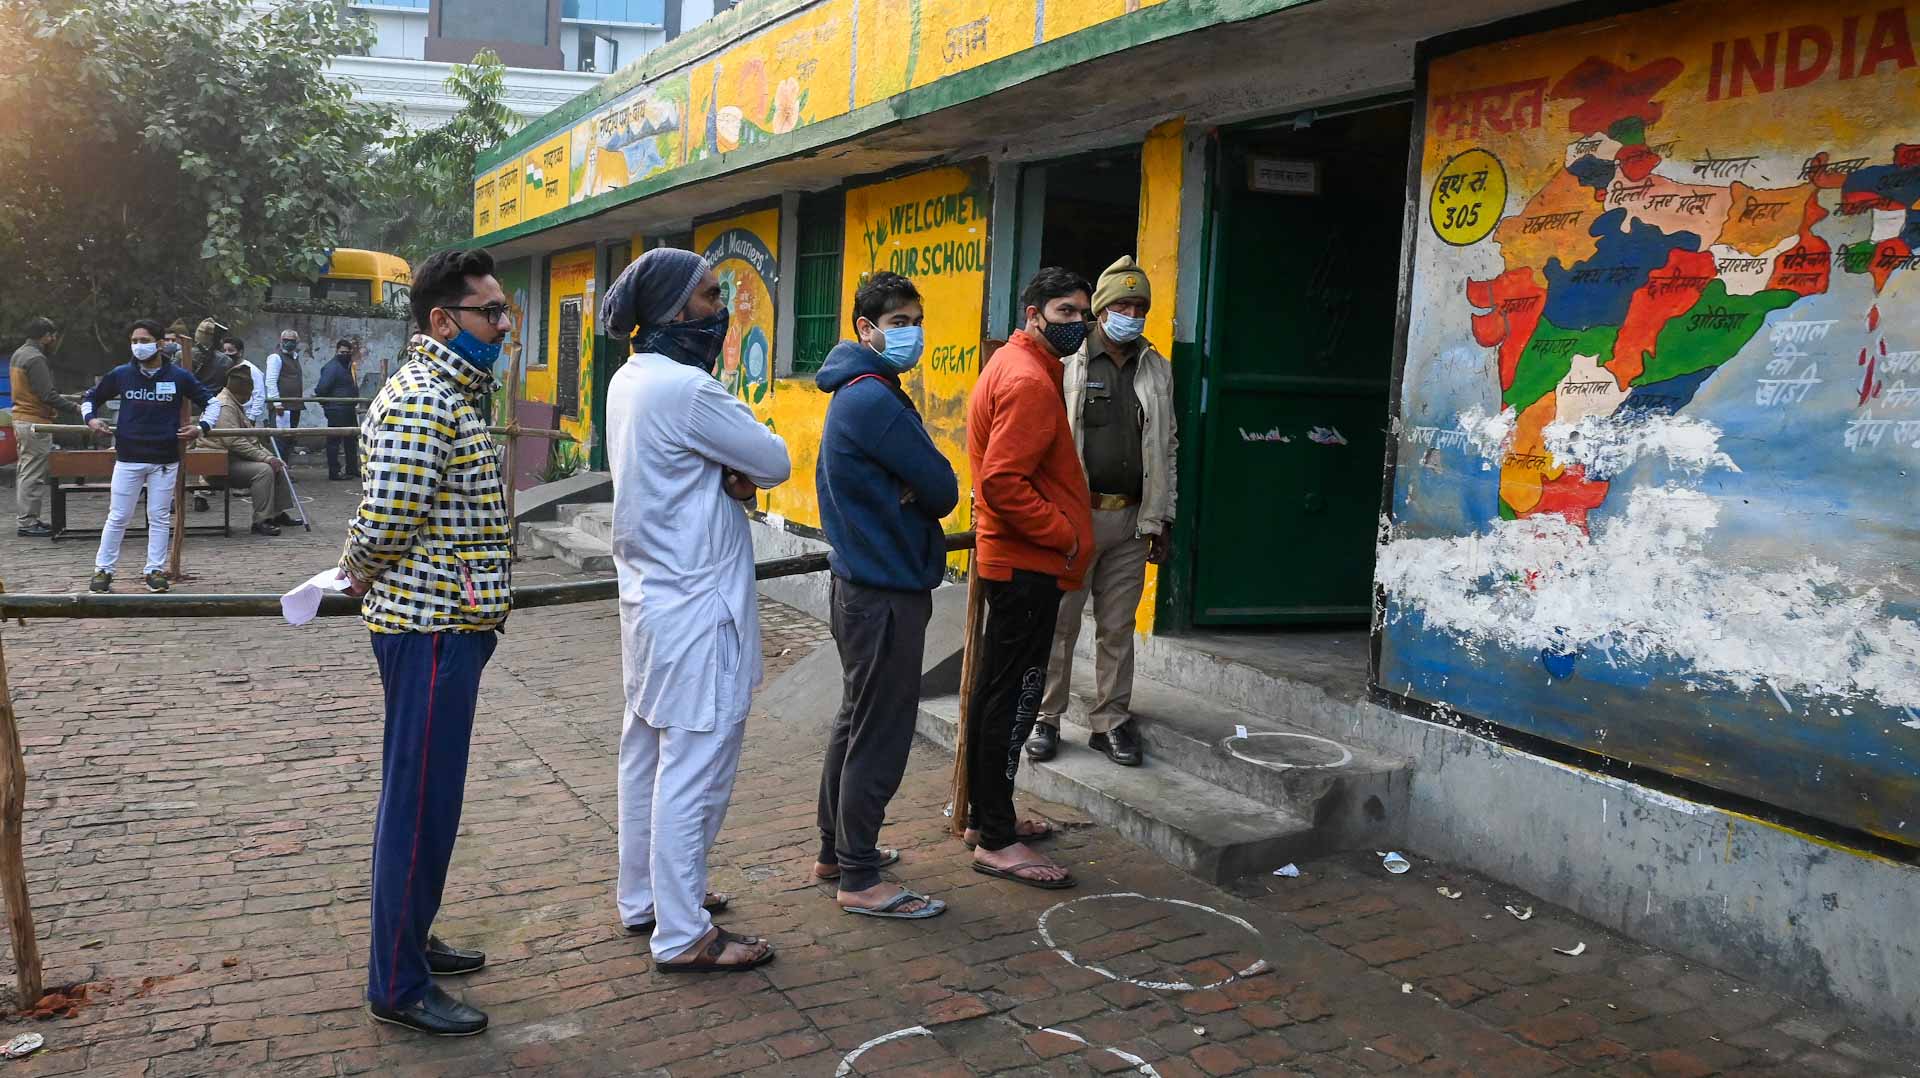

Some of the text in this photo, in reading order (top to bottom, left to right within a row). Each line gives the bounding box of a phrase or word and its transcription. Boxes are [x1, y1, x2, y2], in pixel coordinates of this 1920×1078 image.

[1705, 7, 1917, 102] INDIA
[1432, 76, 1551, 140] भारत
[1692, 147, 1760, 179] नेपाल
[1439, 173, 1468, 204] बूथ
[1609, 177, 1655, 206] दिल्ली
[1643, 189, 1717, 215] उत्तर प्रदेश
[889, 192, 968, 236] WELCOME
[1443, 203, 1482, 229] 305
[1522, 211, 1584, 235] राजस्थान
[1739, 196, 1791, 227] बिहार
[705, 233, 725, 268] Good
[889, 238, 985, 277] OUR SCHOOL
[1686, 304, 1751, 334] ओडिशा
[931, 344, 977, 376] GREAT
[1766, 344, 1809, 376] की
[125, 388, 173, 402] adidas
